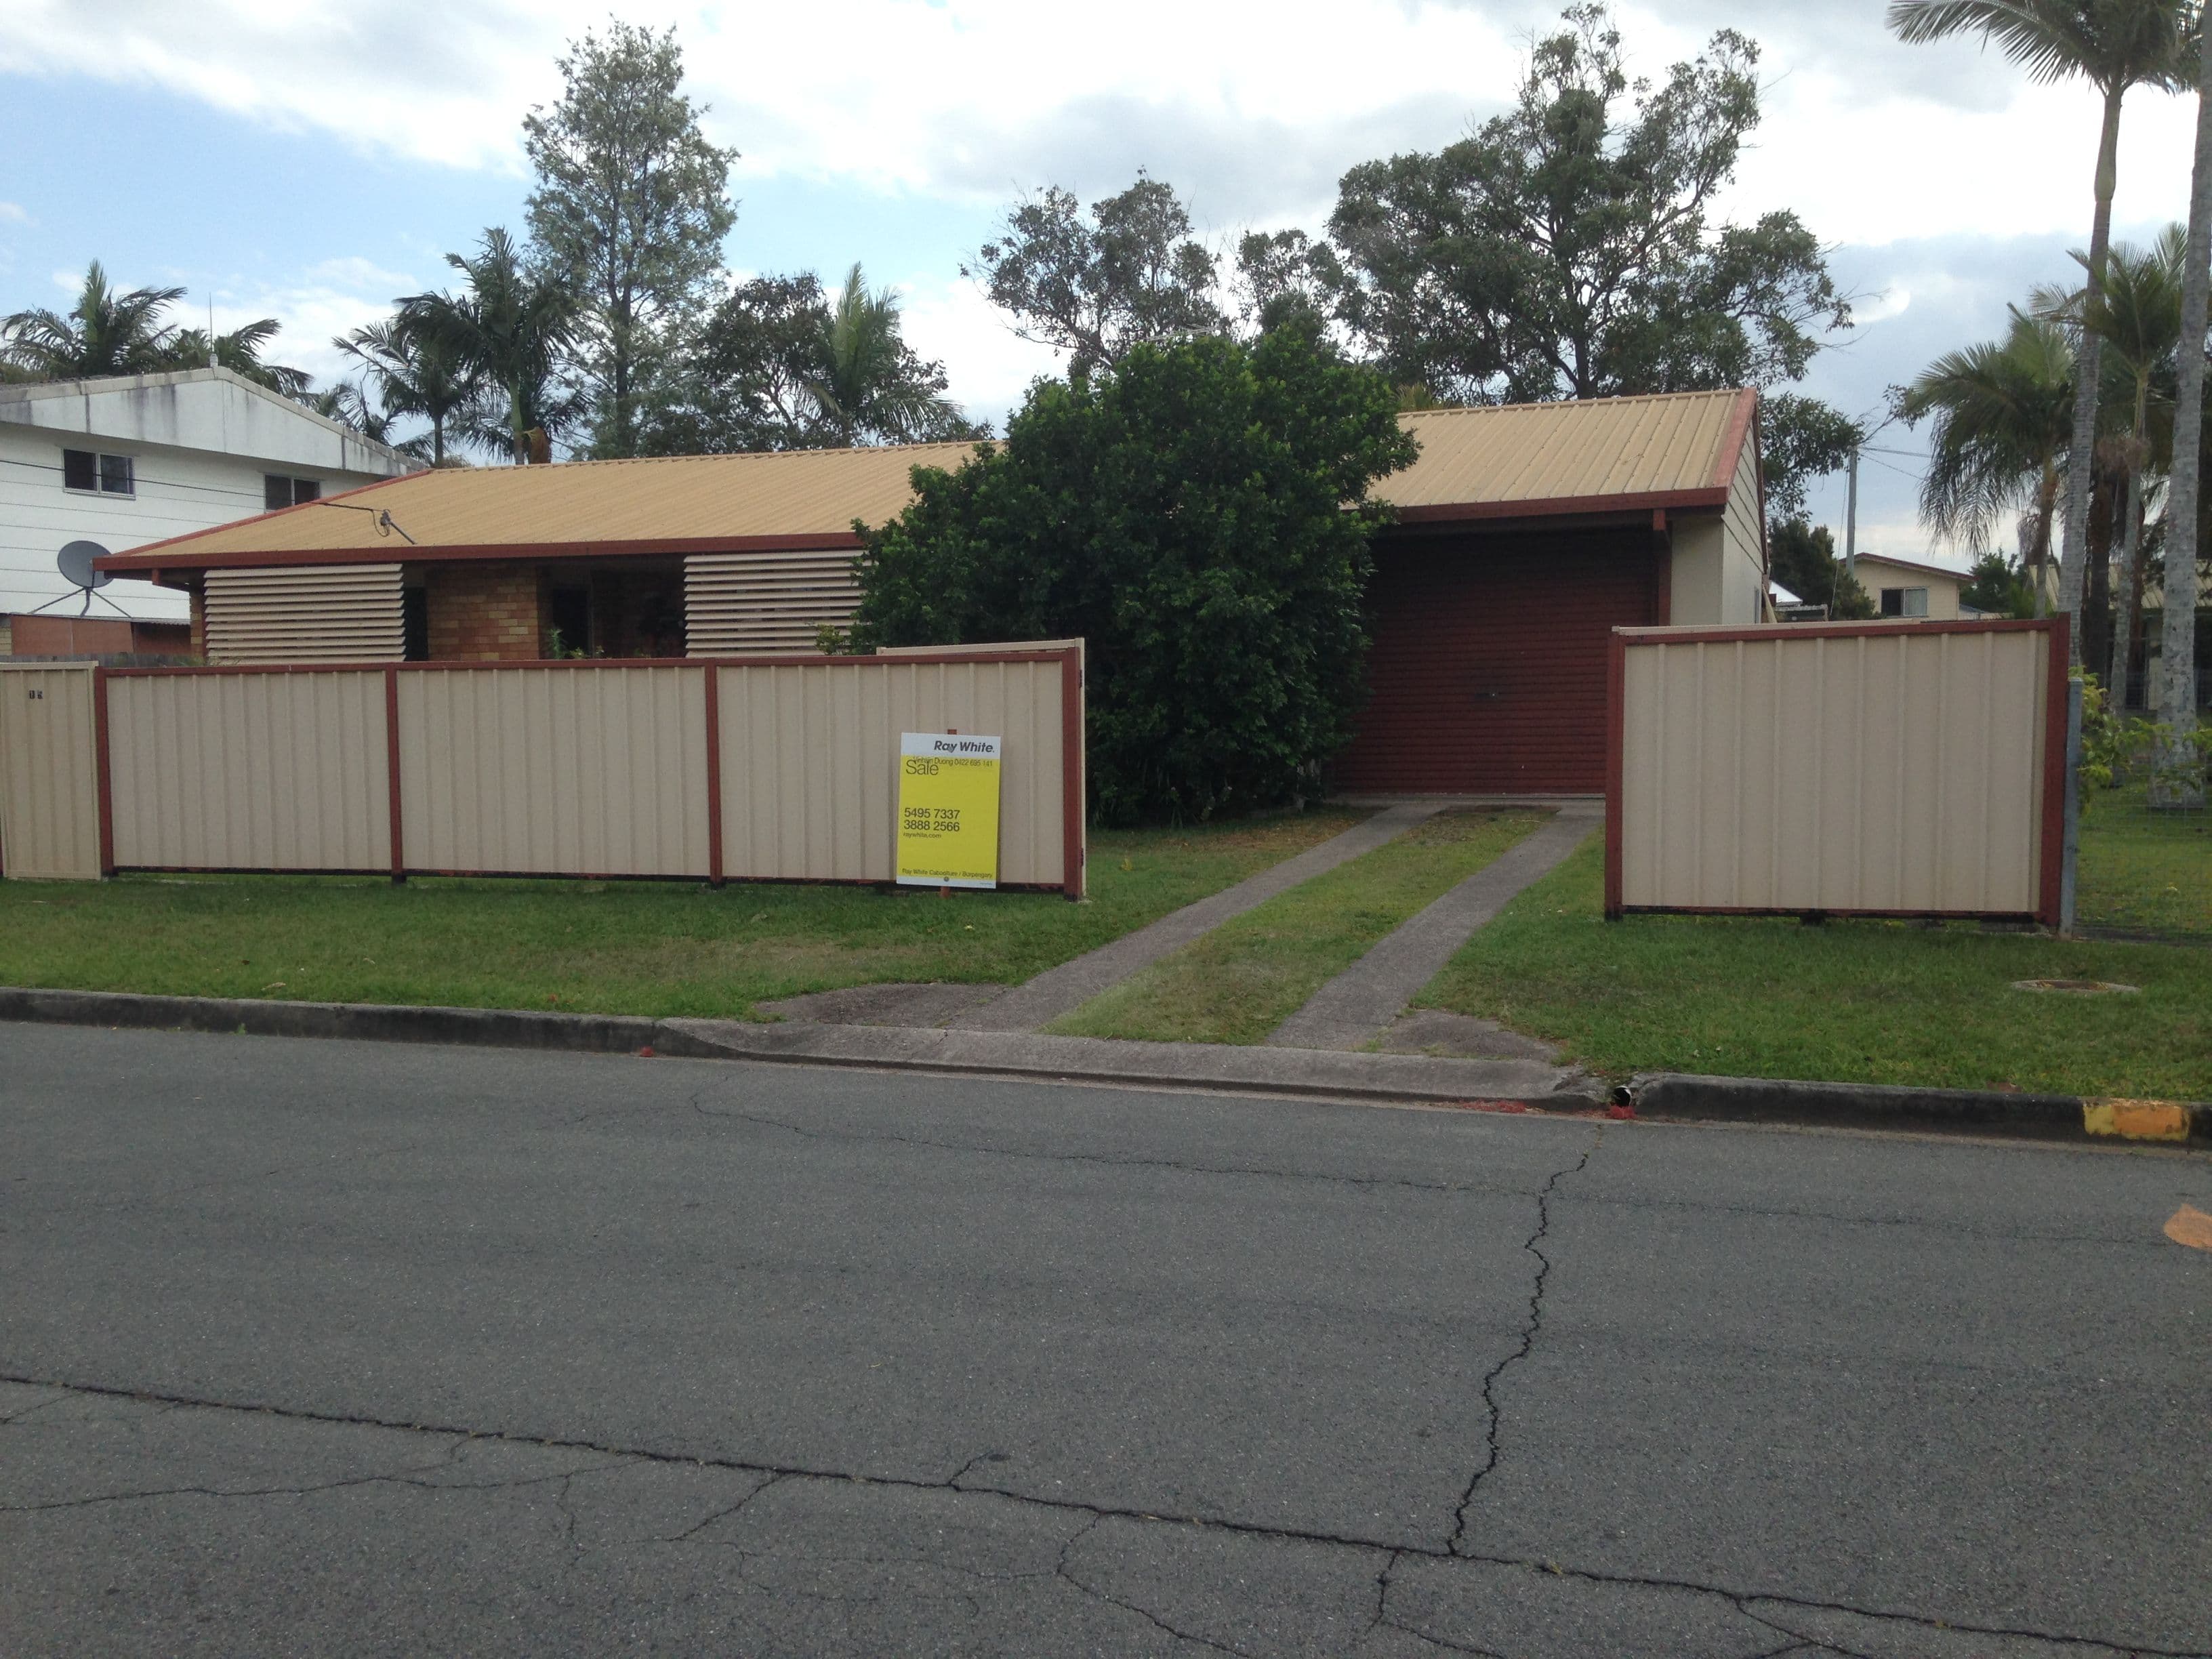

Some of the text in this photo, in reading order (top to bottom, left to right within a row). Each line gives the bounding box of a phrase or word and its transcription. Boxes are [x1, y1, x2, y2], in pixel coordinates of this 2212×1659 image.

[934, 740, 957, 753] Ray
[905, 760, 939, 776] Sale
[955, 758, 969, 766] 0422
[904, 807, 960, 819] 5495 7337
[904, 819, 960, 832] 3888 2566
